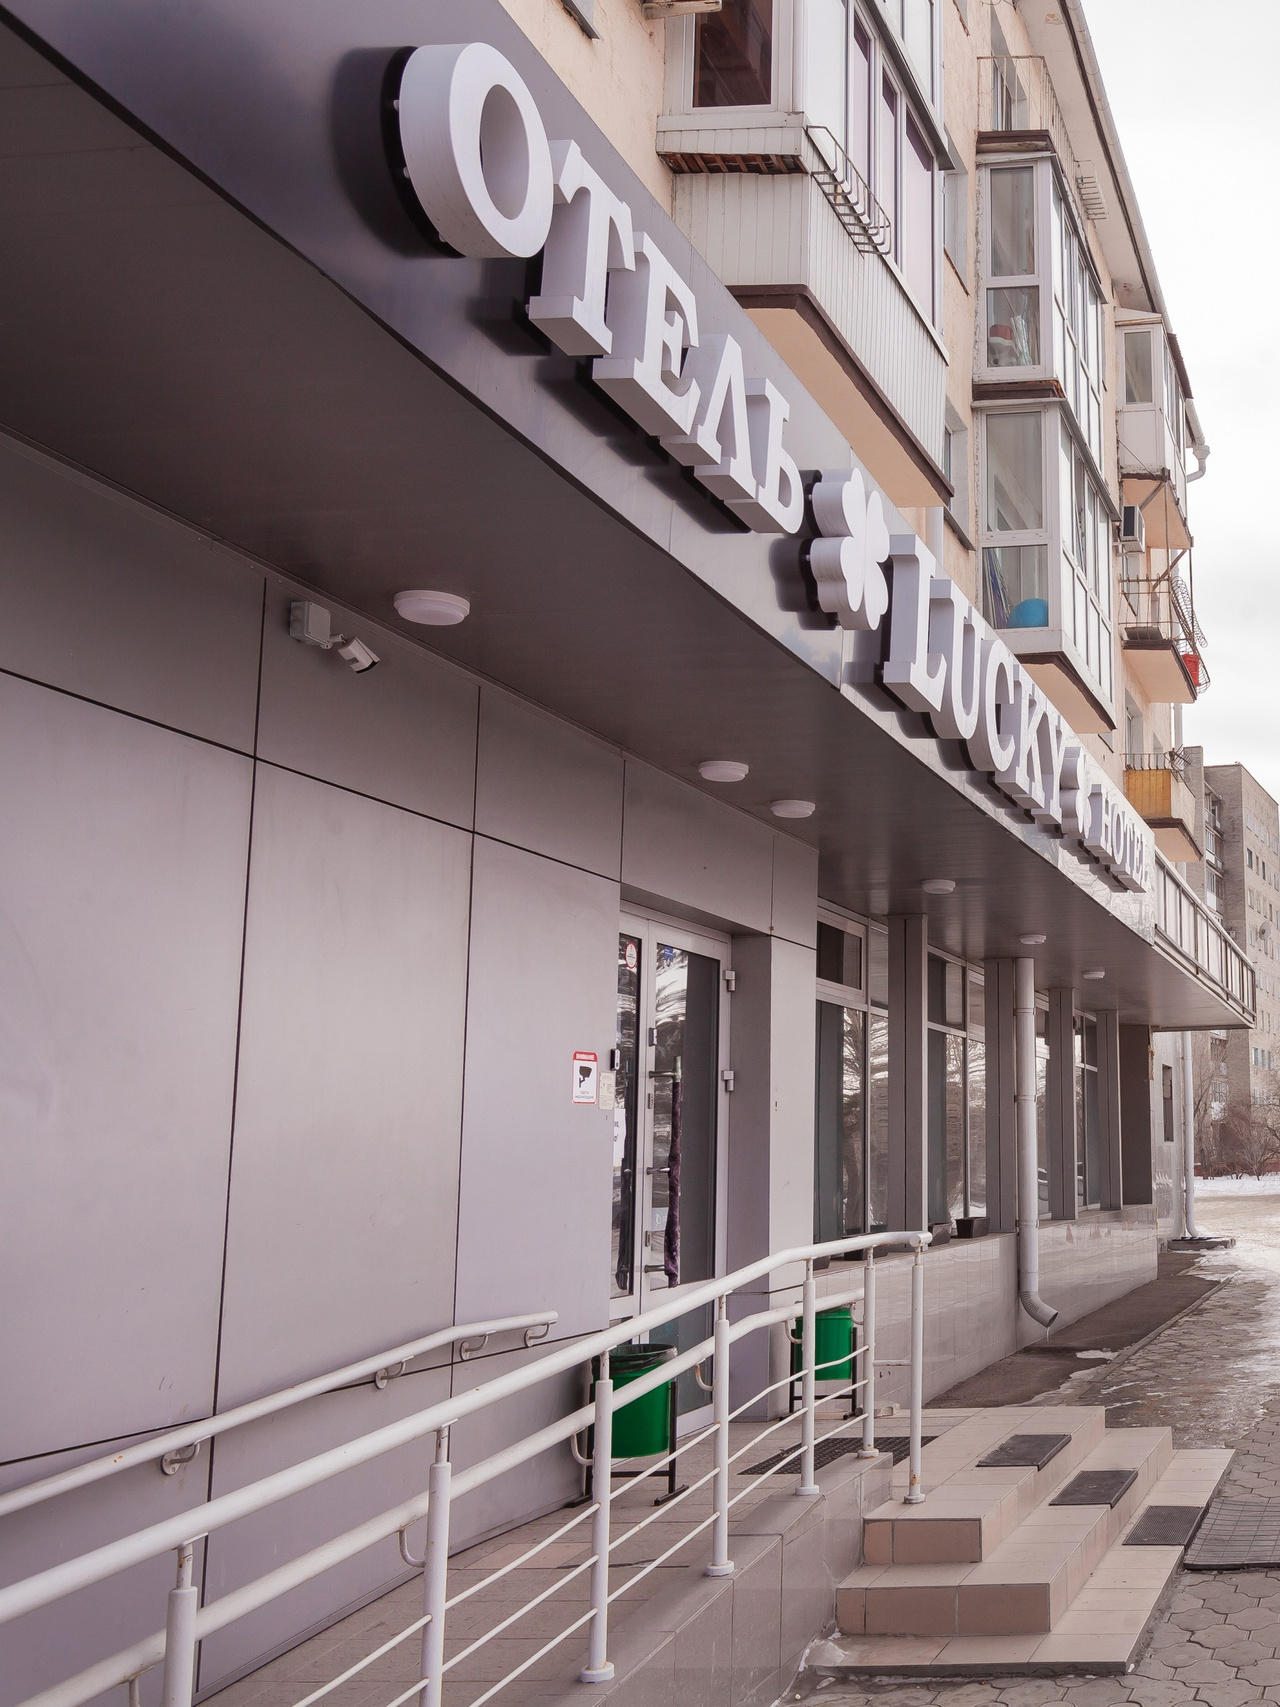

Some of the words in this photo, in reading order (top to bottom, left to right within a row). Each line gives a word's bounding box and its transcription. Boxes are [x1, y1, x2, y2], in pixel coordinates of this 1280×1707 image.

[400, 42, 803, 534] ОТЕЛЬ
[884, 534, 1069, 825] LUCKY
[1085, 784, 1151, 893] HOTEL
